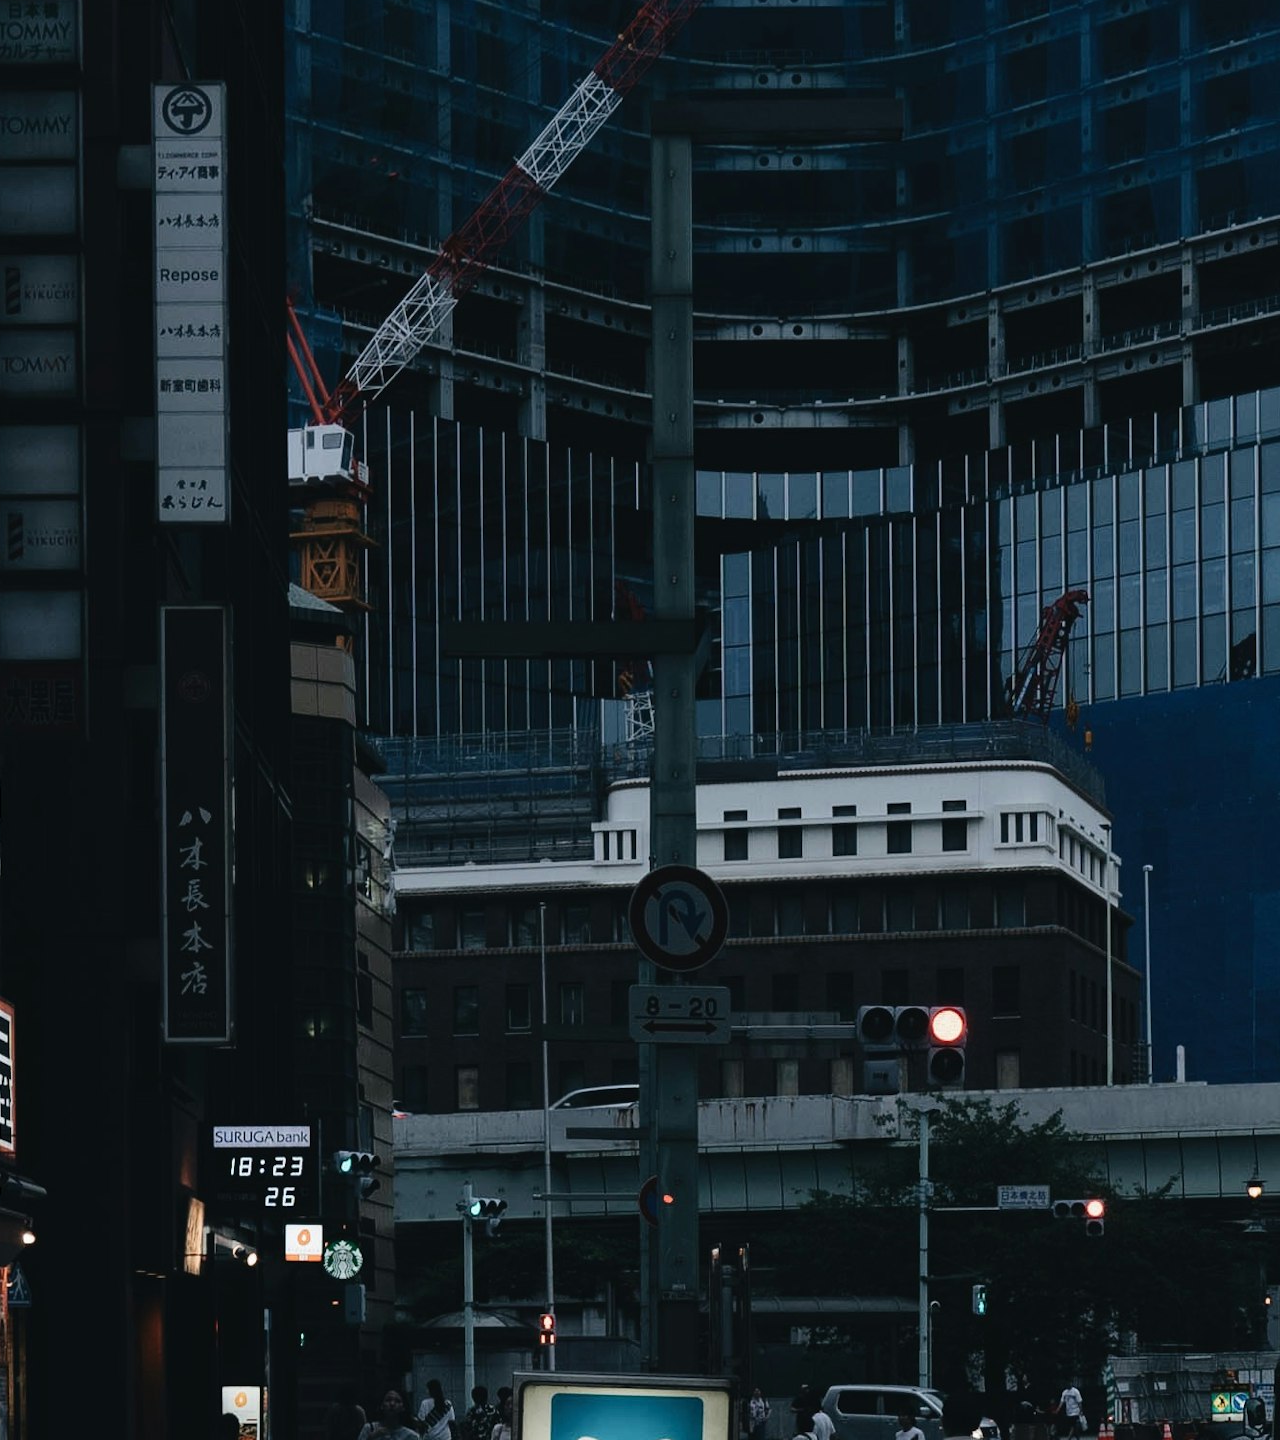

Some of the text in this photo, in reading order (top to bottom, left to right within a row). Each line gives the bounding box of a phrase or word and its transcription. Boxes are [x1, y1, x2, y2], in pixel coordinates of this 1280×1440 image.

[8, 2, 59, 20] 日本橋
[160, 268, 219, 285] Repose
[1, 356, 71, 374] TOMMY
[160, 379, 221, 393] 新室町歯科
[26, 537, 79, 547] KIKUCHI
[215, 1130, 309, 1144] SURUGA bank
[230, 1155, 304, 1177] 18:23
[264, 1186, 296, 1208] 26
